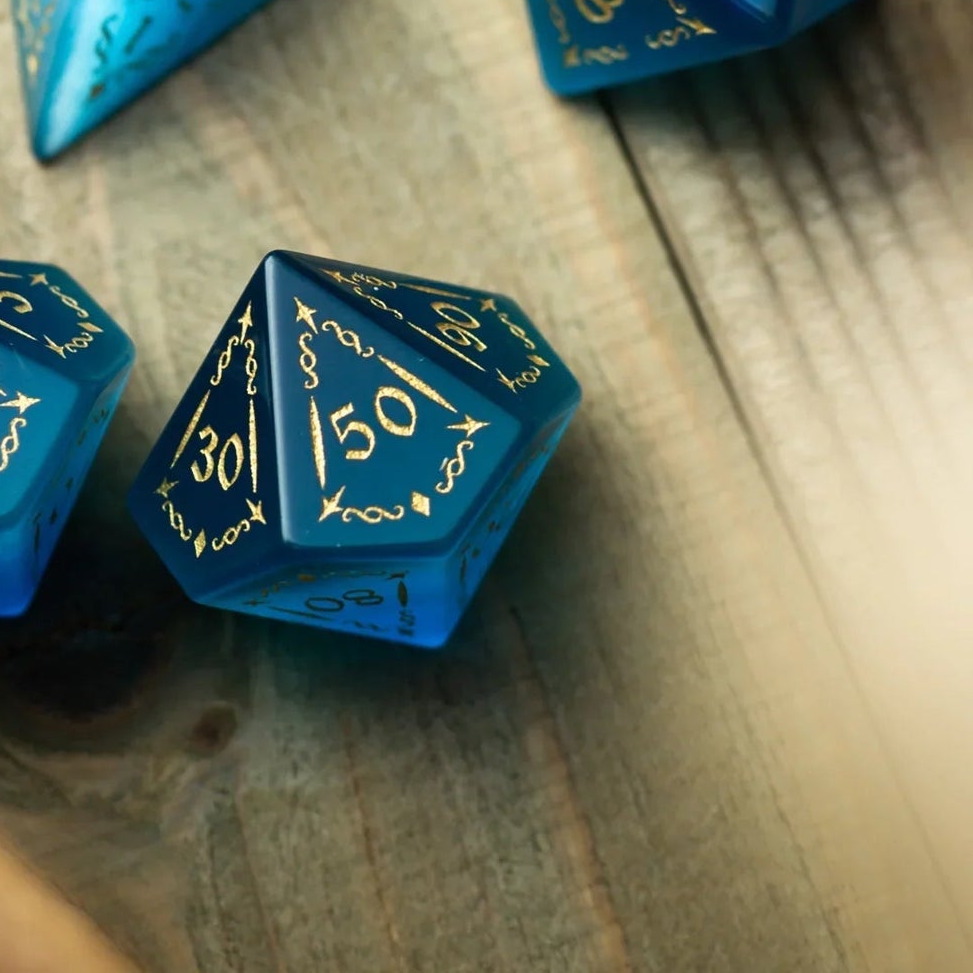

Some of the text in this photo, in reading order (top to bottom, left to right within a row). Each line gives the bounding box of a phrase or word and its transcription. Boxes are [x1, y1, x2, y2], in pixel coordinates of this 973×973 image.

[430, 300, 488, 353] 90
[329, 385, 418, 461] 50
[189, 424, 245, 491] 30
